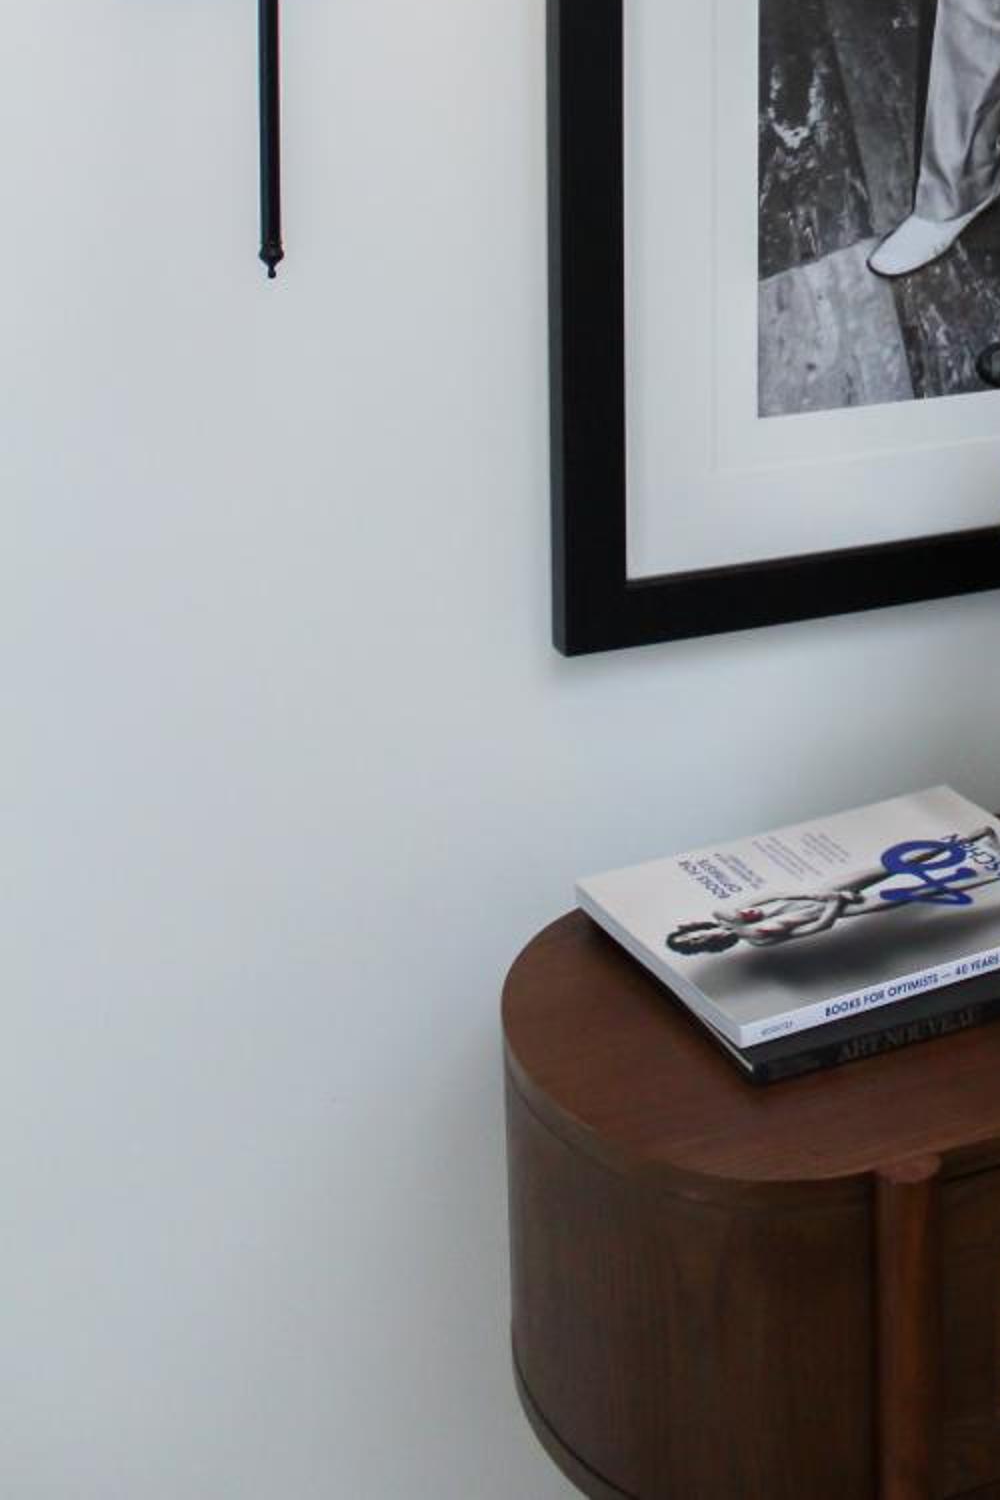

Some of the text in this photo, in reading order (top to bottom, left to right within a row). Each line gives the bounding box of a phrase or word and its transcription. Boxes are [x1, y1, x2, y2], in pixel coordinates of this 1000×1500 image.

[825, 996, 861, 1017] BOOKS
[863, 989, 885, 1006] FOR
[887, 974, 939, 998] OPTIMISTS
[955, 963, 969, 976] 40
[970, 953, 999, 973] YEARS
